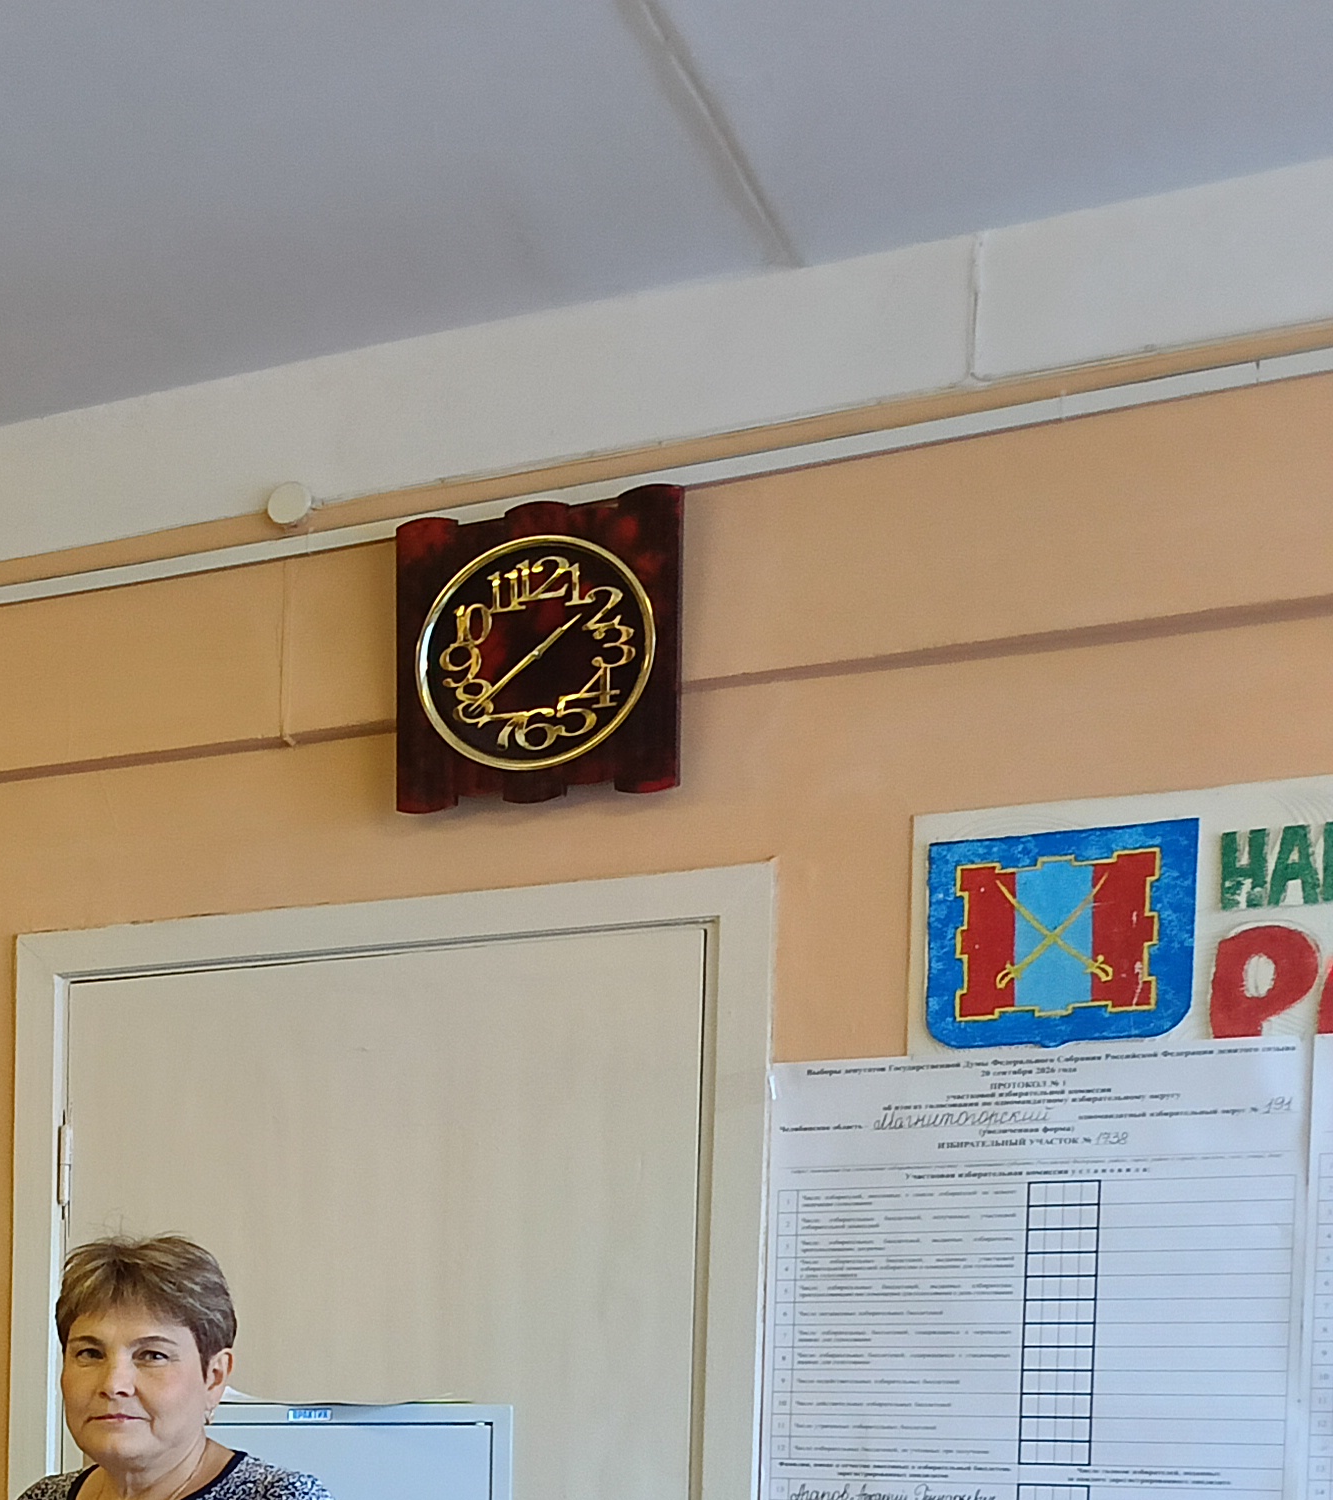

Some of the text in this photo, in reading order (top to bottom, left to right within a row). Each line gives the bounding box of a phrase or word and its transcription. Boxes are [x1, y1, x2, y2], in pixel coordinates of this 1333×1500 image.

[591, 623, 636, 669] 3
[440, 643, 482, 688] 9
[990, 1081, 1046, 1090] ПРОТОКОЛ
[873, 1107, 1050, 1131] Магнитогорский
